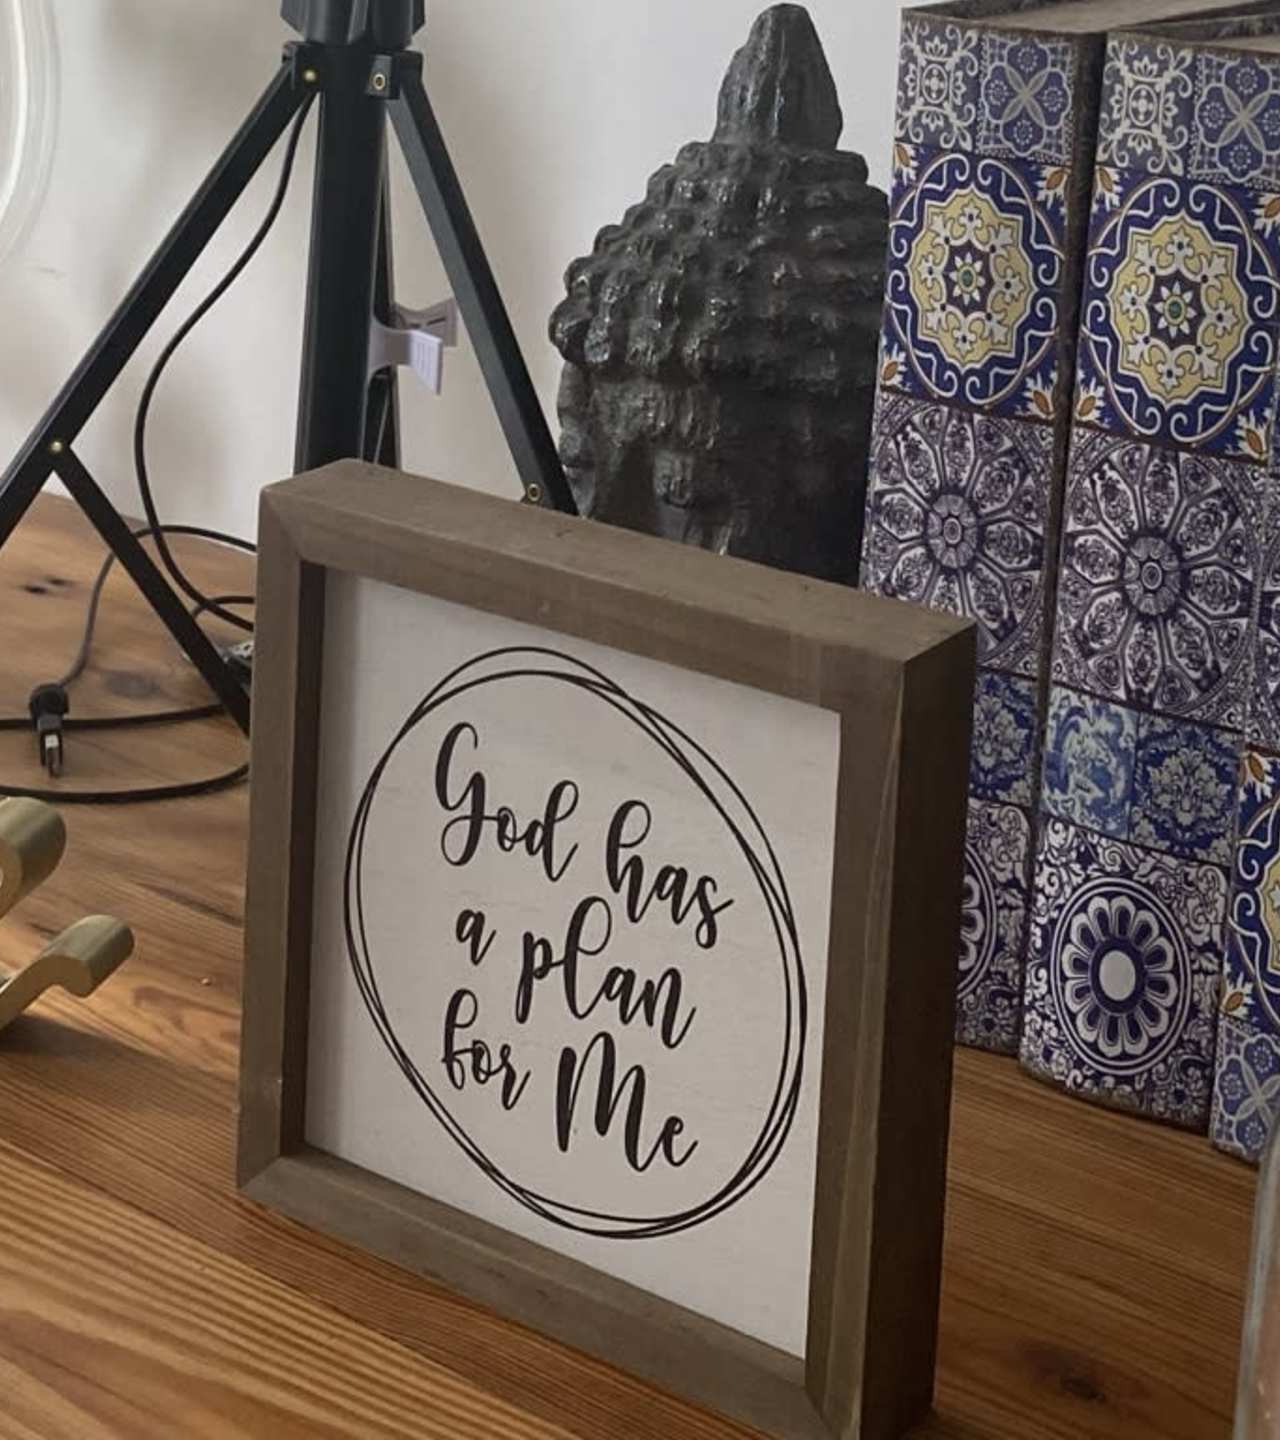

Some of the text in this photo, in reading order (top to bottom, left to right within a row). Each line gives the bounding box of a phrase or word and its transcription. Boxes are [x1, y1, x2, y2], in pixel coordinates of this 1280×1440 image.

[435, 720, 733, 949] God has
[455, 895, 697, 1049] a plan
[442, 988, 698, 1172] for Me
